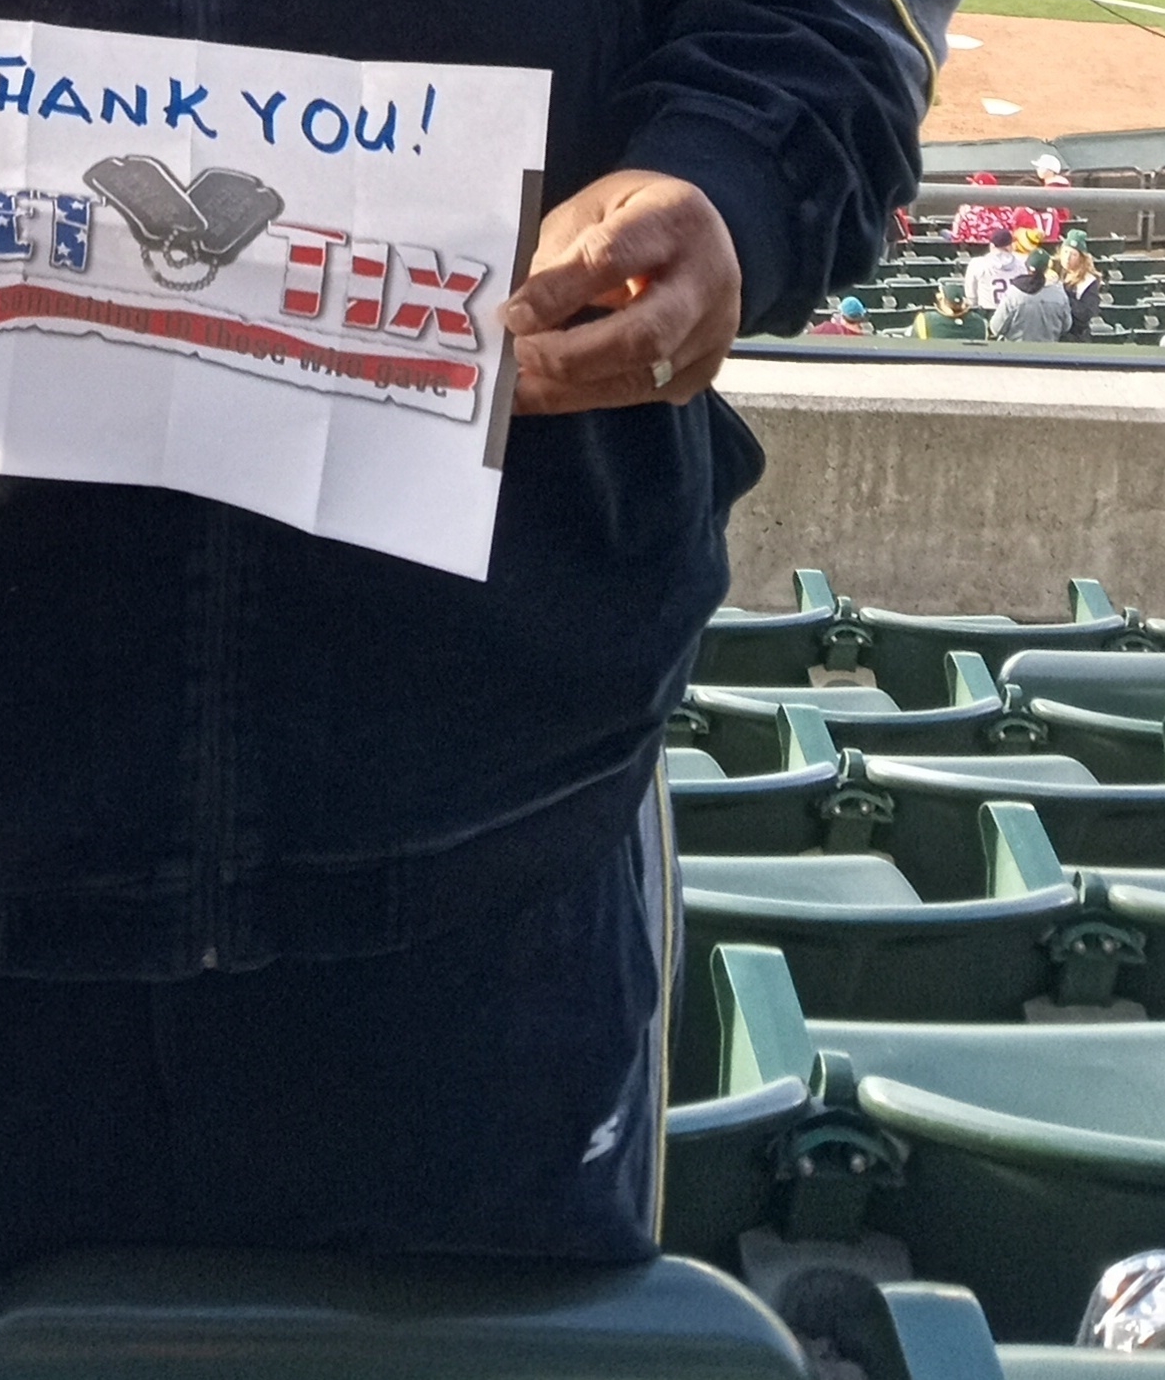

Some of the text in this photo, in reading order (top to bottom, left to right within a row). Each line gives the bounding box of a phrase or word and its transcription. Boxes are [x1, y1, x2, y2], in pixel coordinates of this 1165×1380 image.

[241, 83, 437, 156] YOU!
[268, 219, 490, 352] TIX
[0, 287, 151, 335] something
[163, 312, 193, 341] to
[205, 319, 285, 366] those
[300, 346, 364, 379] who
[374, 359, 451, 398] gave
